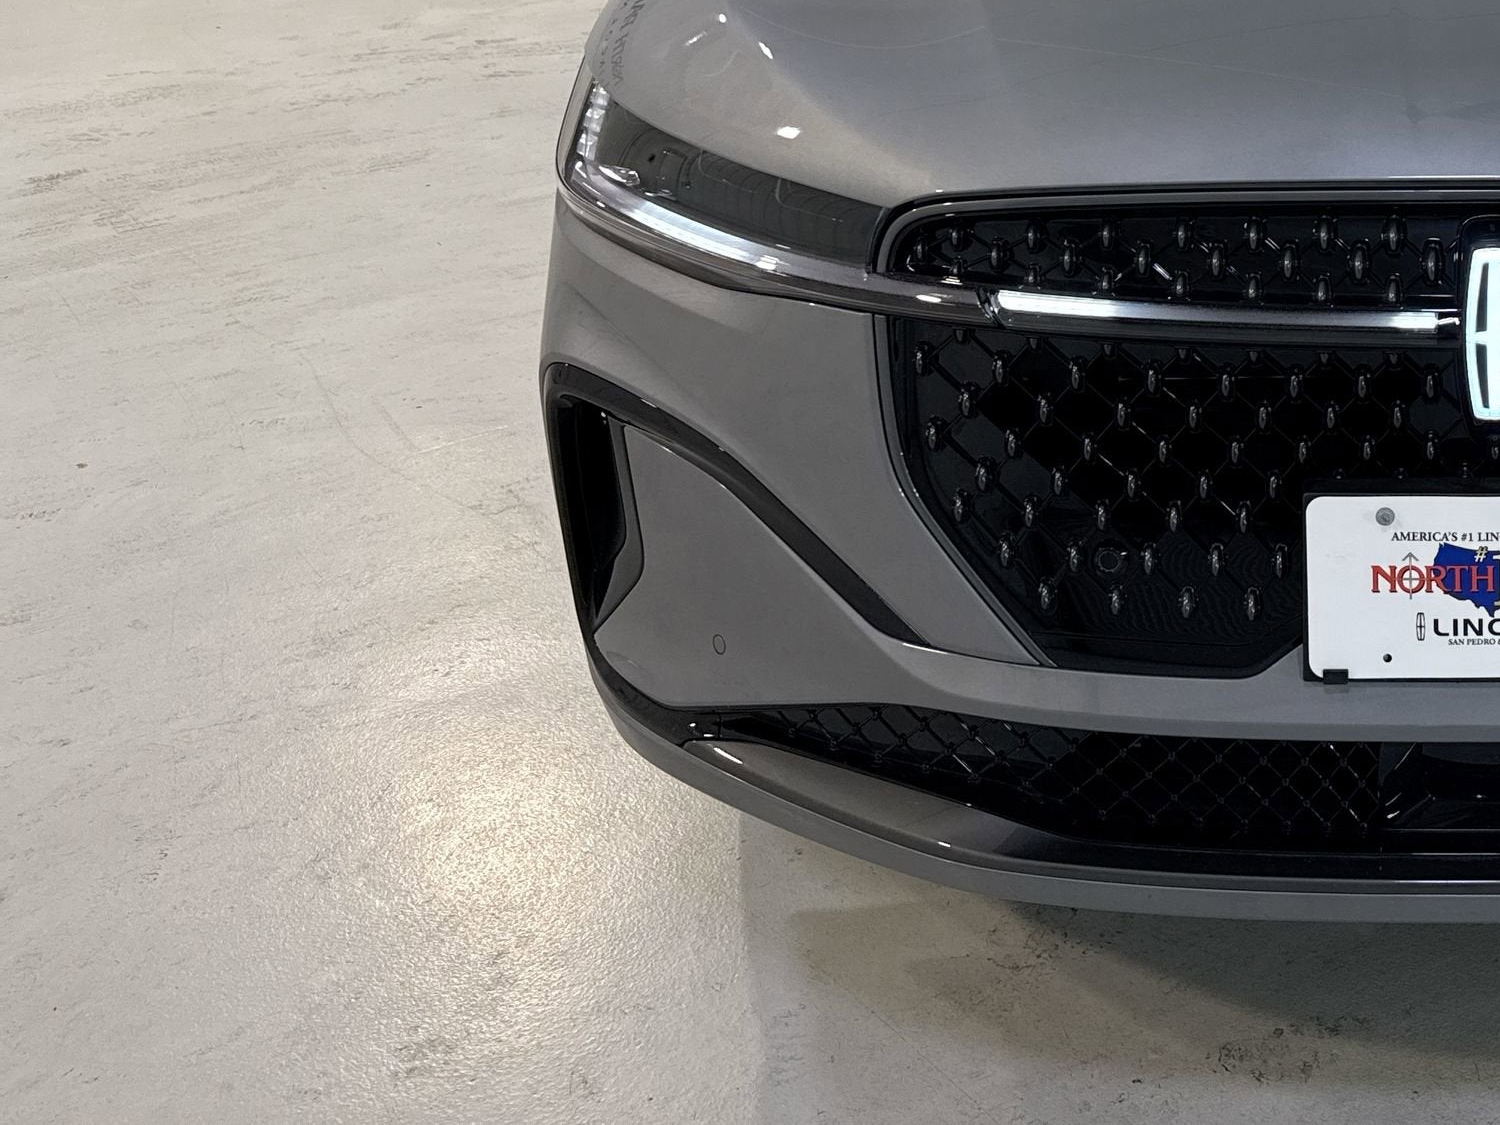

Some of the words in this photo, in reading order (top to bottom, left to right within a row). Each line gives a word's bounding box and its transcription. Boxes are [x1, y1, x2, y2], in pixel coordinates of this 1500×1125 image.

[1391, 531, 1459, 542] AMERICA'S
[1460, 532, 1474, 542] #1
[1370, 564, 1495, 594] NORTH
[1447, 638, 1465, 646] SAN
[1466, 638, 1496, 646] PEDRO
